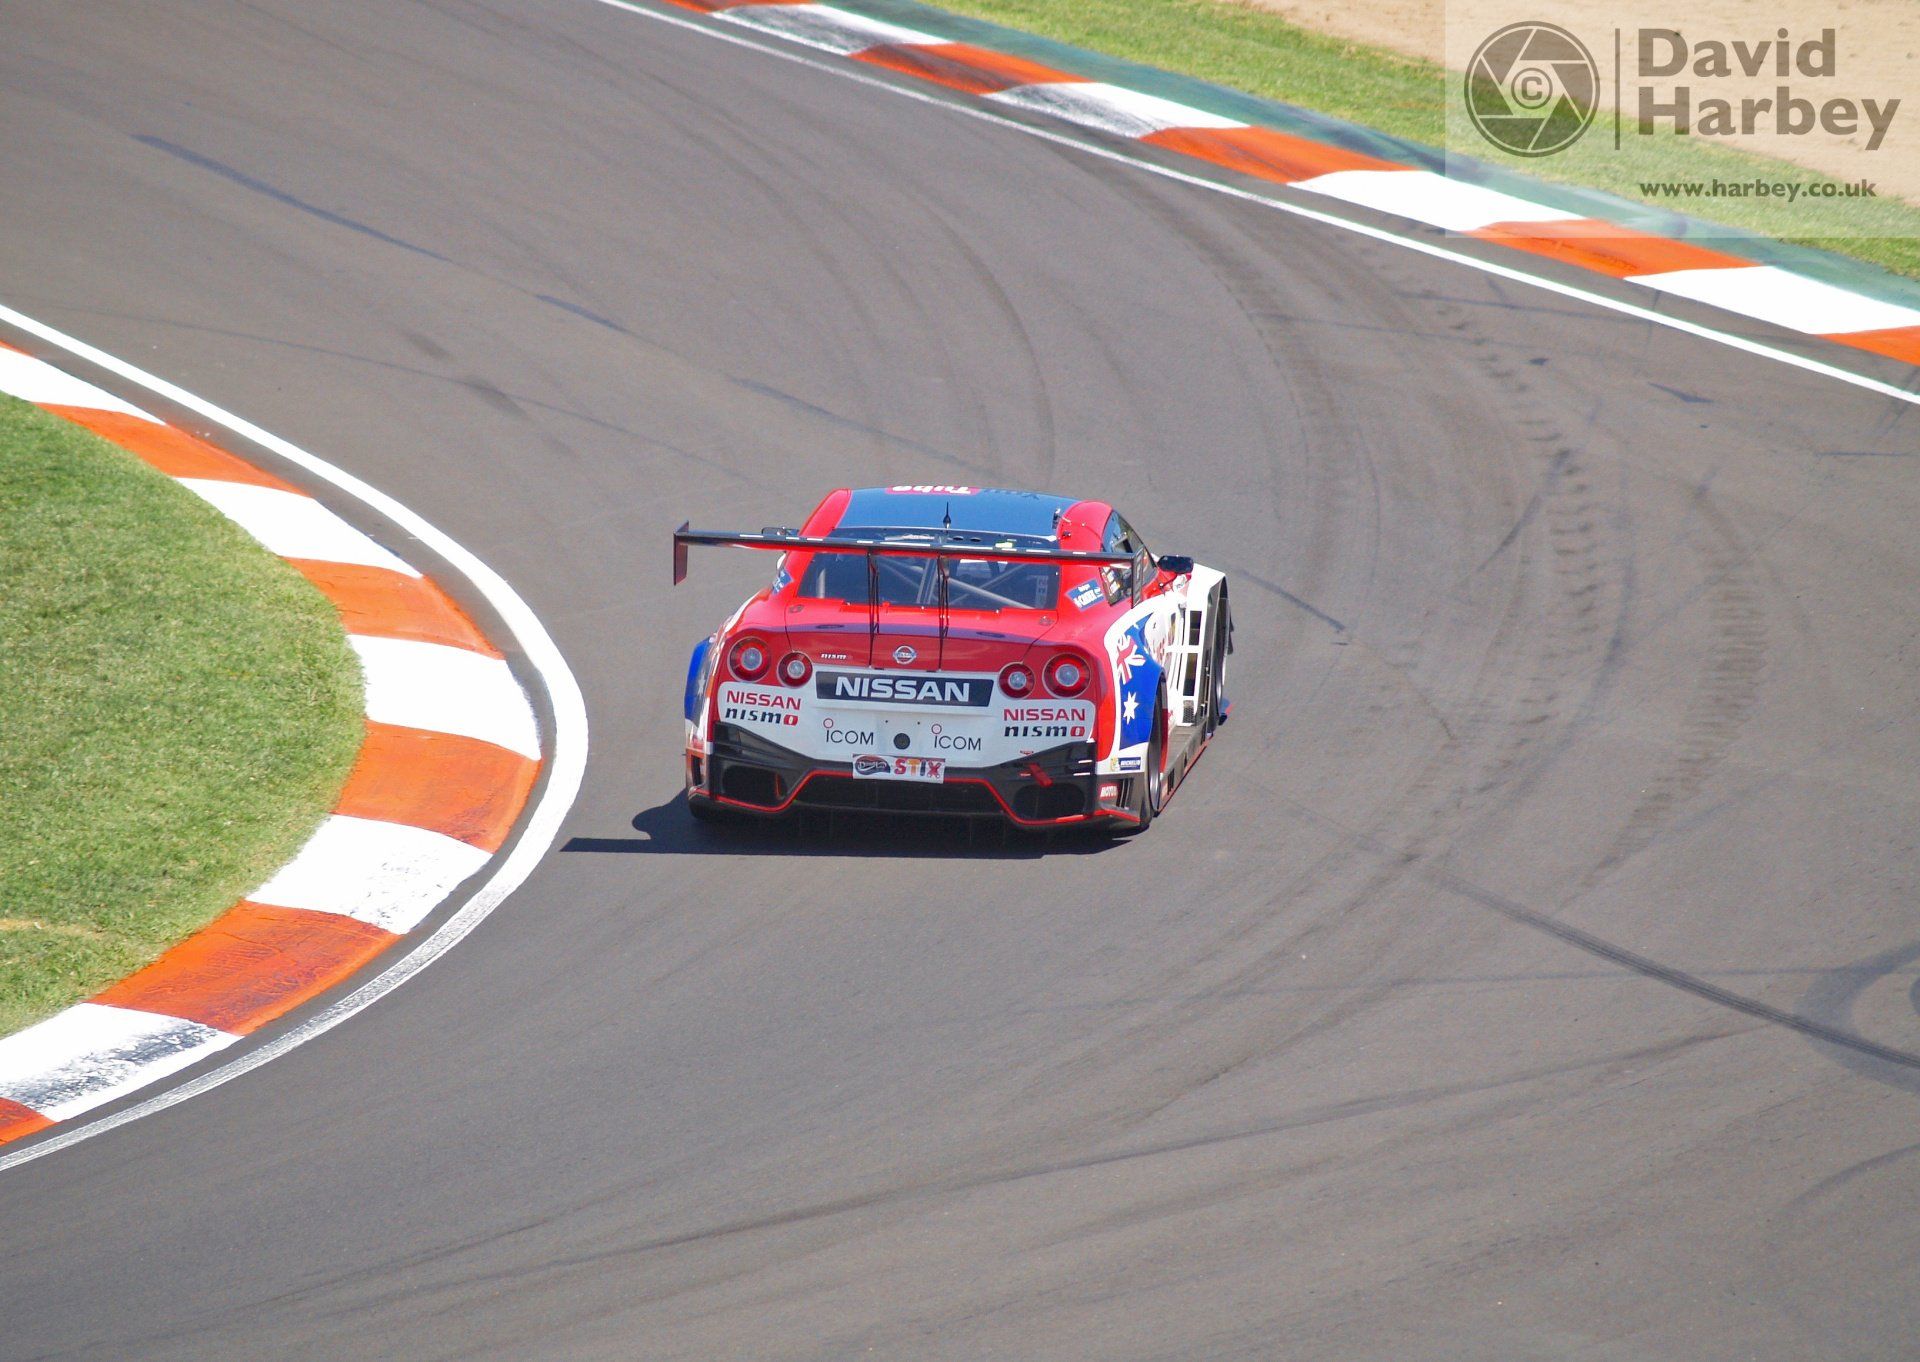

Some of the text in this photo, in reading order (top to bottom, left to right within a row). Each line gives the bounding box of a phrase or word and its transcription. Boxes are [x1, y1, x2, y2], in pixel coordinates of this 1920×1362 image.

[835, 676, 970, 702] NISSAN
[726, 690, 801, 711] NISSAN
[725, 708, 799, 726] nismo
[1003, 708, 1086, 722] NISSAN
[1004, 725, 1086, 737] nismo
[894, 758, 942, 778] STIX
